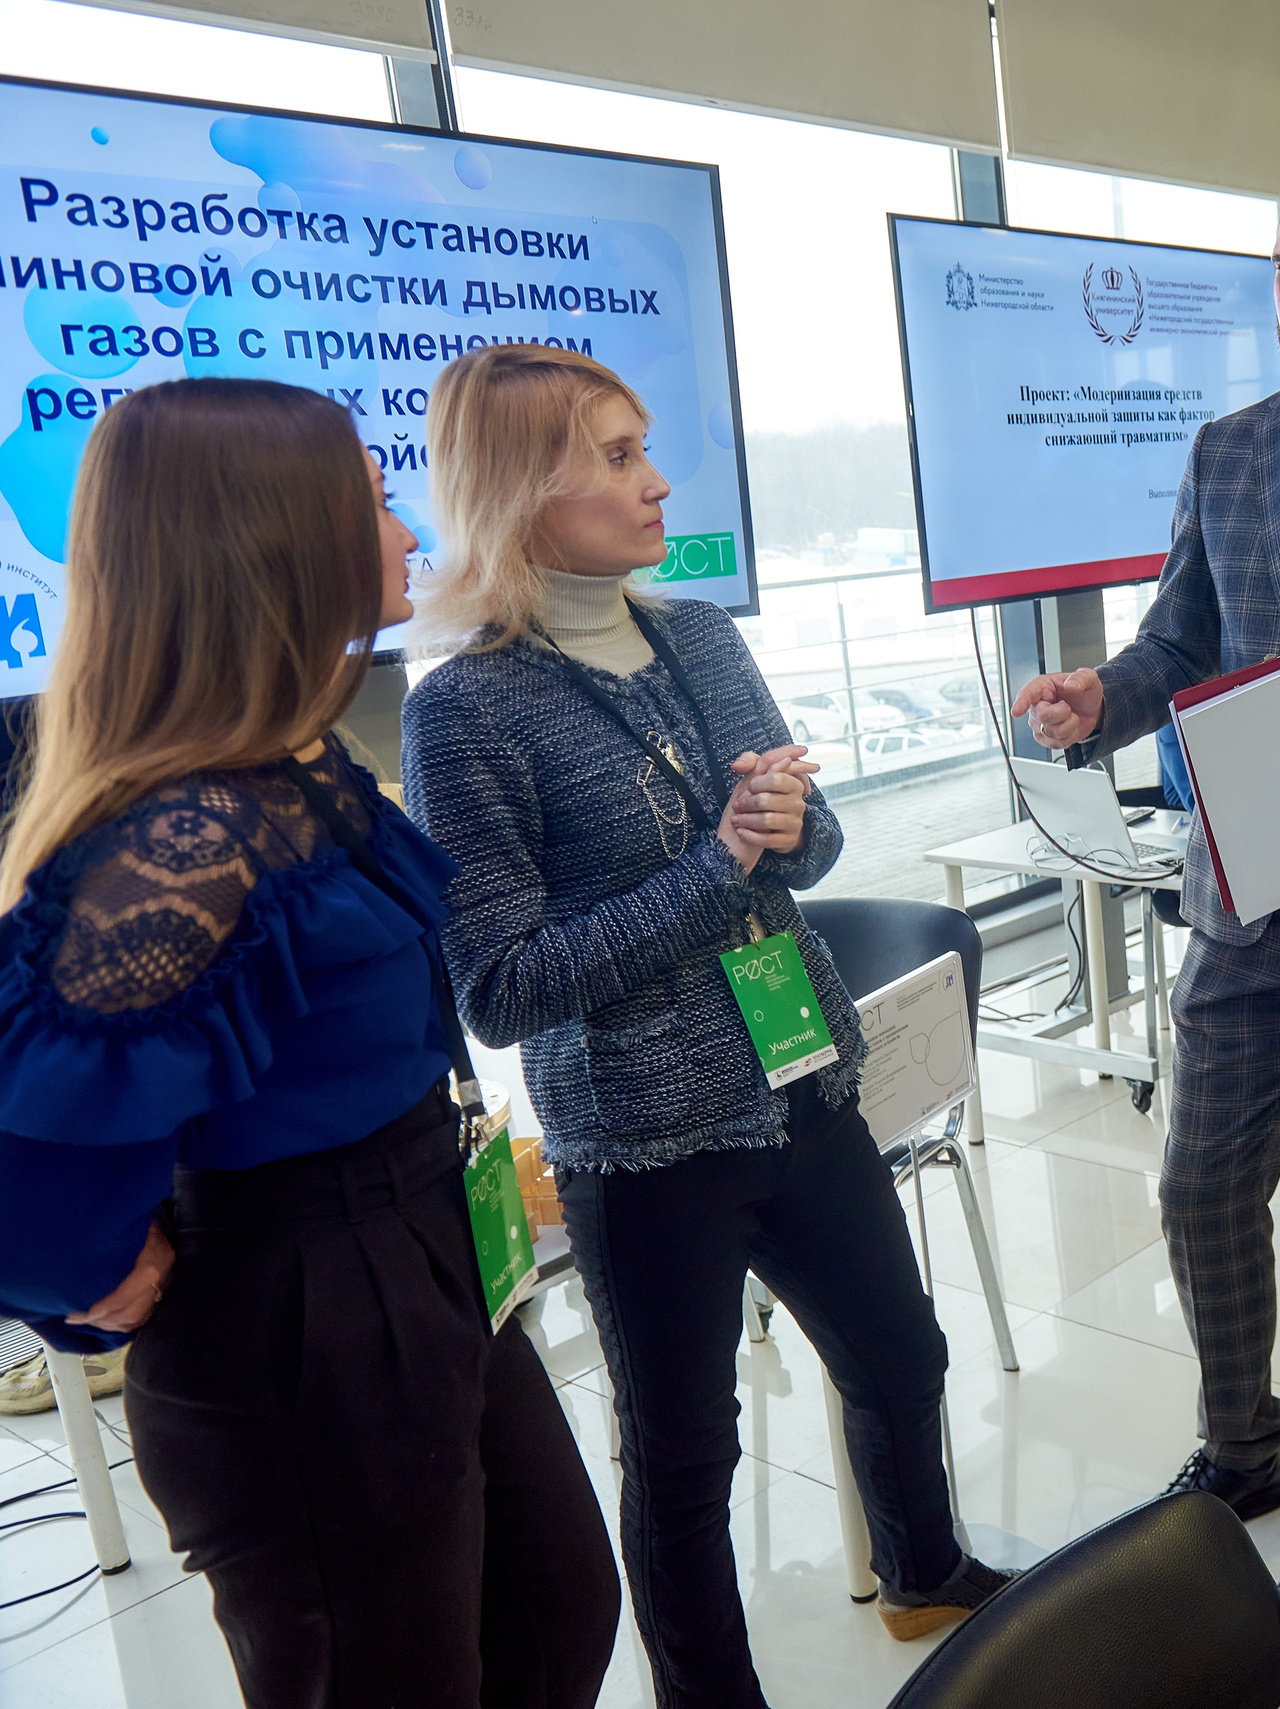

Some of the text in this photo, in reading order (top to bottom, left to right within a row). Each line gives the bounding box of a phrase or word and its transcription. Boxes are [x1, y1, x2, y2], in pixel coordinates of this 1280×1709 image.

[20, 177, 590, 261] Разработка установки
[978, 273, 1024, 286] Министерство
[251, 268, 448, 307] очистки
[462, 280, 661, 315] дымовых
[980, 287, 1020, 298] образования
[980, 300, 1054, 312] Нижегородской области
[1095, 306, 1134, 317] университет
[60, 323, 593, 370] газов с применем
[1020, 385, 1203, 405] Проект: «Модернизация средств
[1007, 407, 1215, 428] индивидуальной защиты как фактор
[1045, 430, 1189, 447] снижающий травматизм»
[6, 563, 58, 600] ИНСТИТУТ
[768, 1028, 817, 1056] Участник
